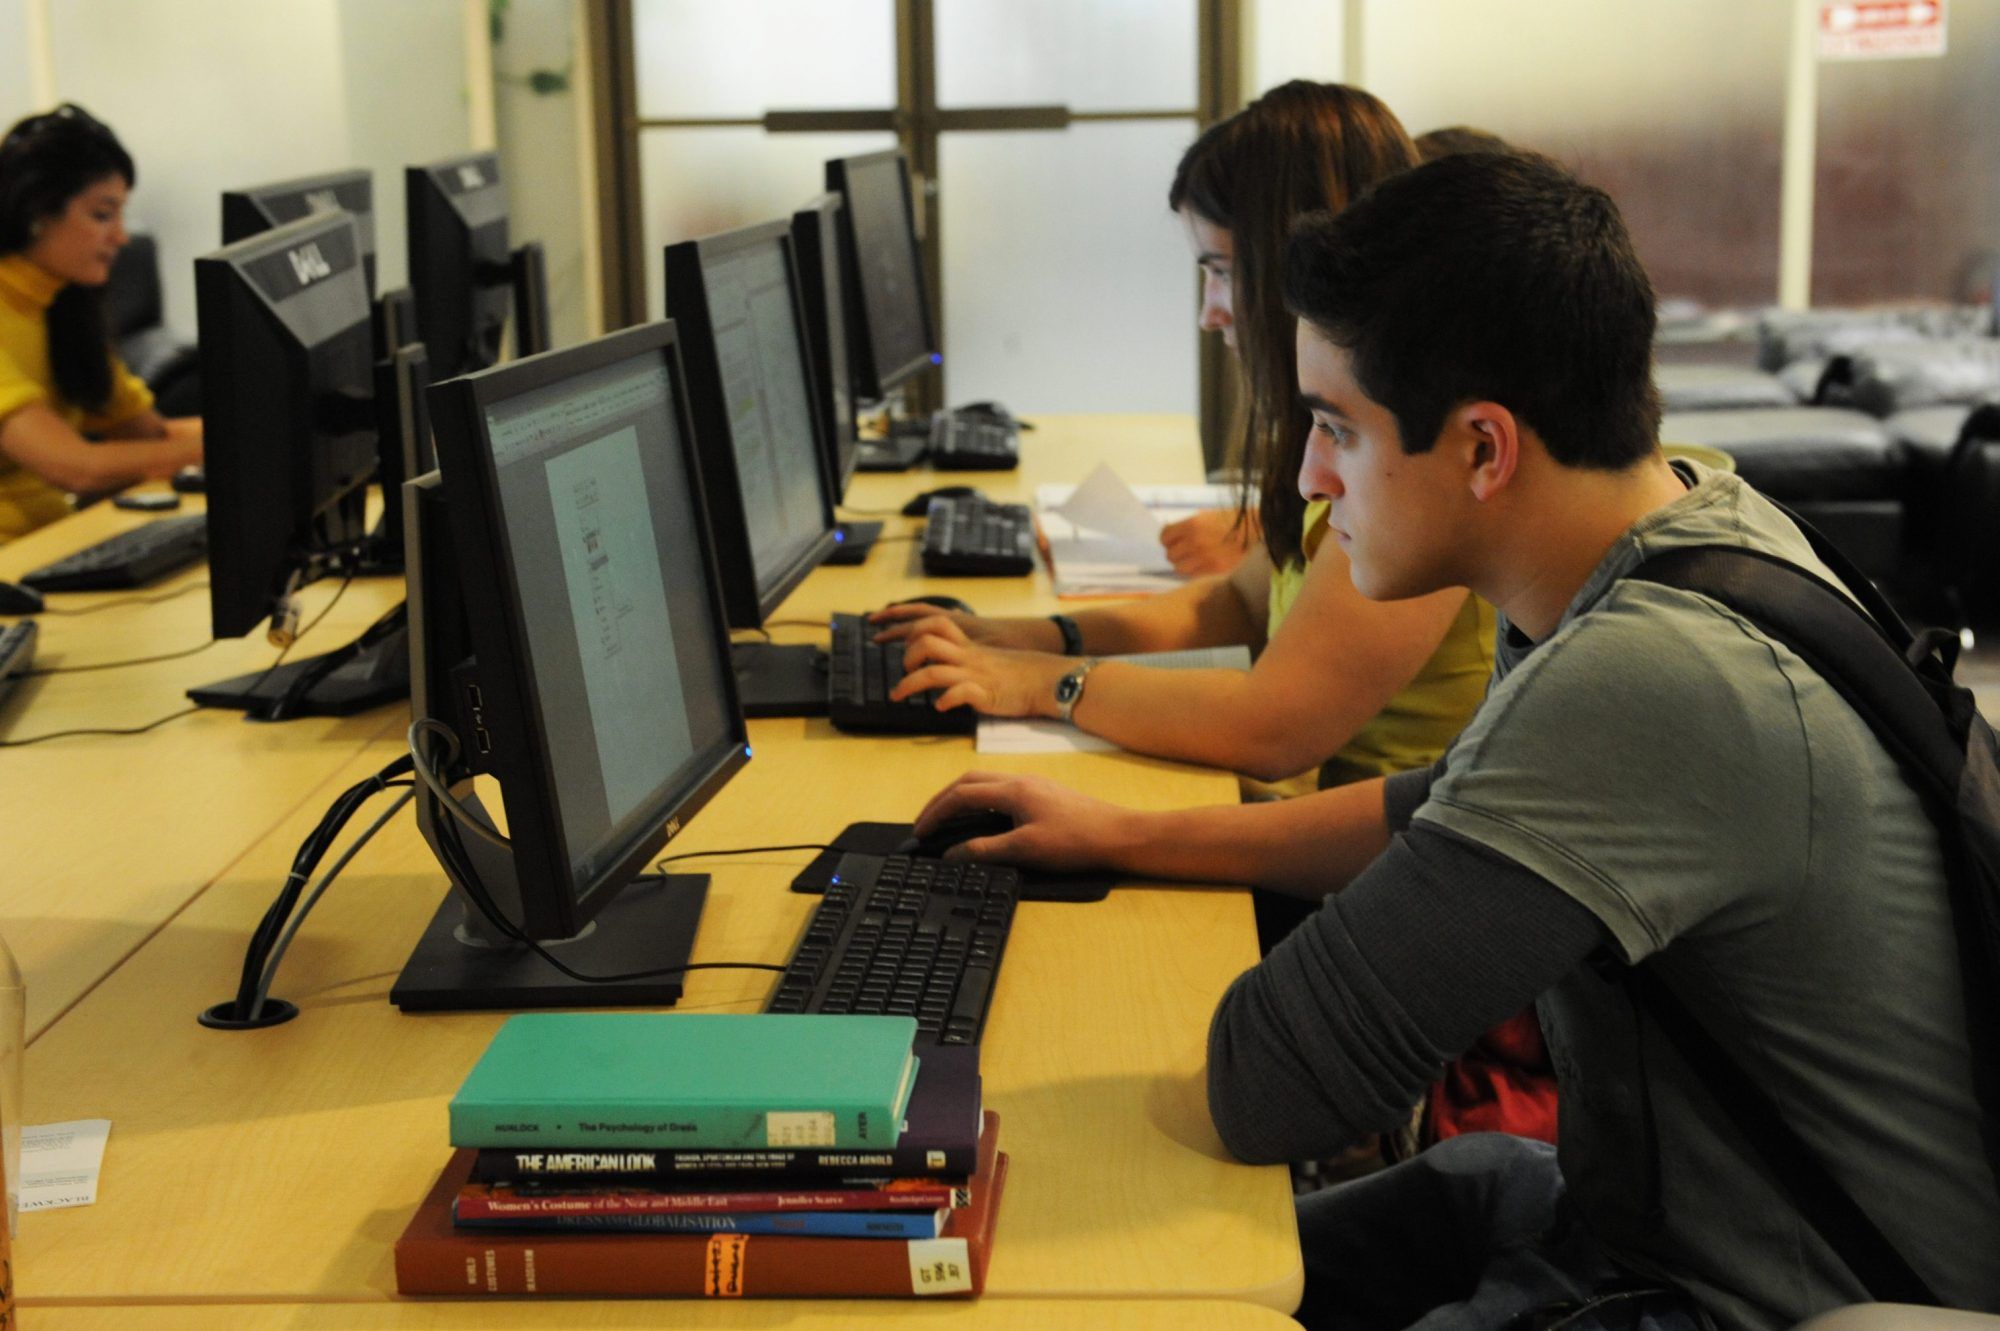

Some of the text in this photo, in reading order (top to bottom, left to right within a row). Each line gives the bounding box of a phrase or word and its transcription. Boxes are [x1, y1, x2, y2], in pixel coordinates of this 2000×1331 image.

[578, 1122, 596, 1133] The
[599, 1123, 655, 1135] Psychology
[515, 1154, 656, 1172] THE AMERICAN LOOK
[818, 1154, 893, 1166] REBECCA ARNOLD
[488, 1196, 728, 1212] Women's Costume of the Near and Middle East
[627, 1215, 737, 1229] GLOBALISATION
